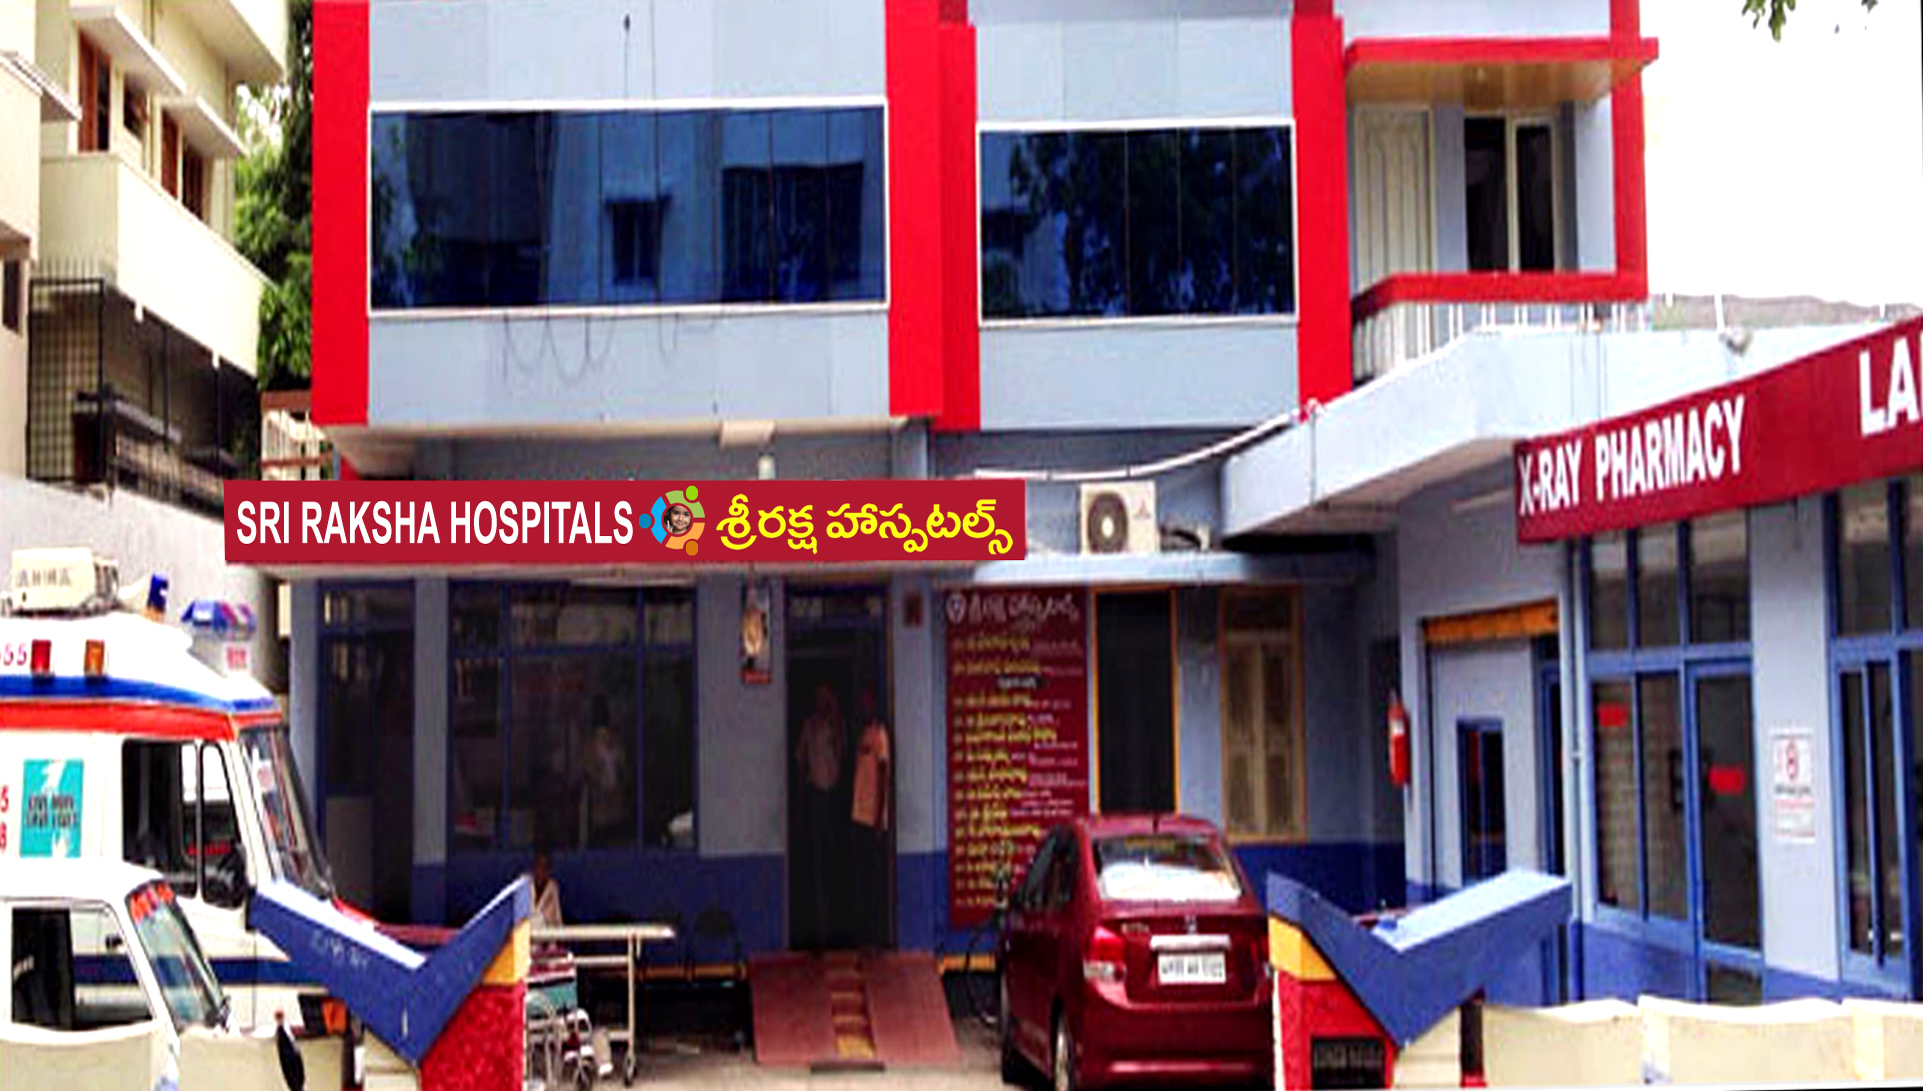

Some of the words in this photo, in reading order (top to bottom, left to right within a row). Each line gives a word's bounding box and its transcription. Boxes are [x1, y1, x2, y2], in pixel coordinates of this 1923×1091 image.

[1518, 439, 1582, 515] X-RAY
[1595, 394, 1745, 502] PHARMACY
[1858, 331, 1923, 438] LA
[236, 500, 290, 544] SRI
[301, 500, 440, 544] RAKSHA
[450, 500, 634, 544] HOSPITALS
